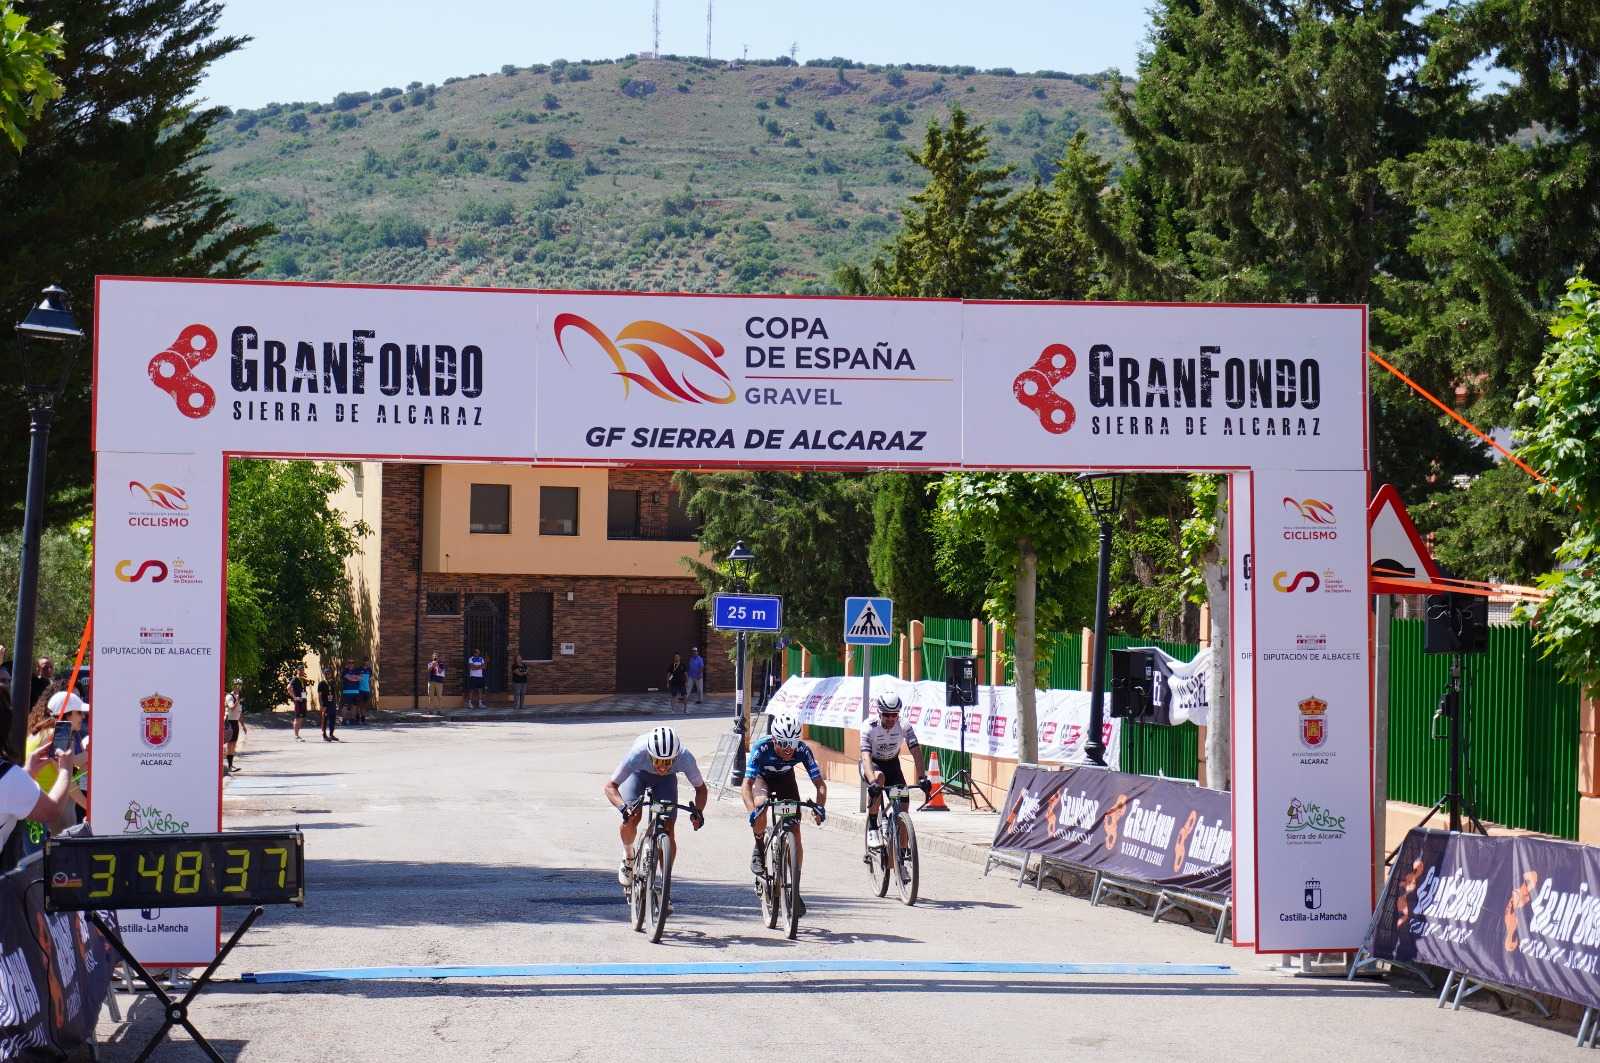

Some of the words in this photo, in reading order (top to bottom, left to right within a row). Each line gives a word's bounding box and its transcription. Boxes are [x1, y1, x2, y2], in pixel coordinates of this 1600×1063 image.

[745, 316, 830, 340] COPA
[745, 346, 785, 370] DE
[796, 342, 916, 371] ESPAÑA
[744, 387, 843, 406] GRAVEL
[232, 400, 318, 423] SIERRA
[335, 403, 359, 423] DE
[377, 405, 483, 426] ALCARAZ
[1092, 416, 1170, 435] SIERRA
[1185, 416, 1208, 436] DE
[1223, 417, 1321, 436] ALCARAZ
[585, 426, 626, 448] GF
[631, 427, 736, 449] SIERRA
[743, 429, 785, 450] DE
[789, 430, 928, 451] ALCARAZ
[128, 517, 189, 527] CICLISMO
[1283, 531, 1337, 540] CICLISMO
[727, 606, 747, 620] 25
[752, 610, 766, 620] m
[154, 647, 167, 655] DE
[168, 647, 212, 656] ALBACETE
[1310, 653, 1320, 661] DE
[1322, 653, 1360, 661] ALBACETE
[1318, 832, 1343, 840] Alcaraz
[119, 923, 157, 933] astilla-La
